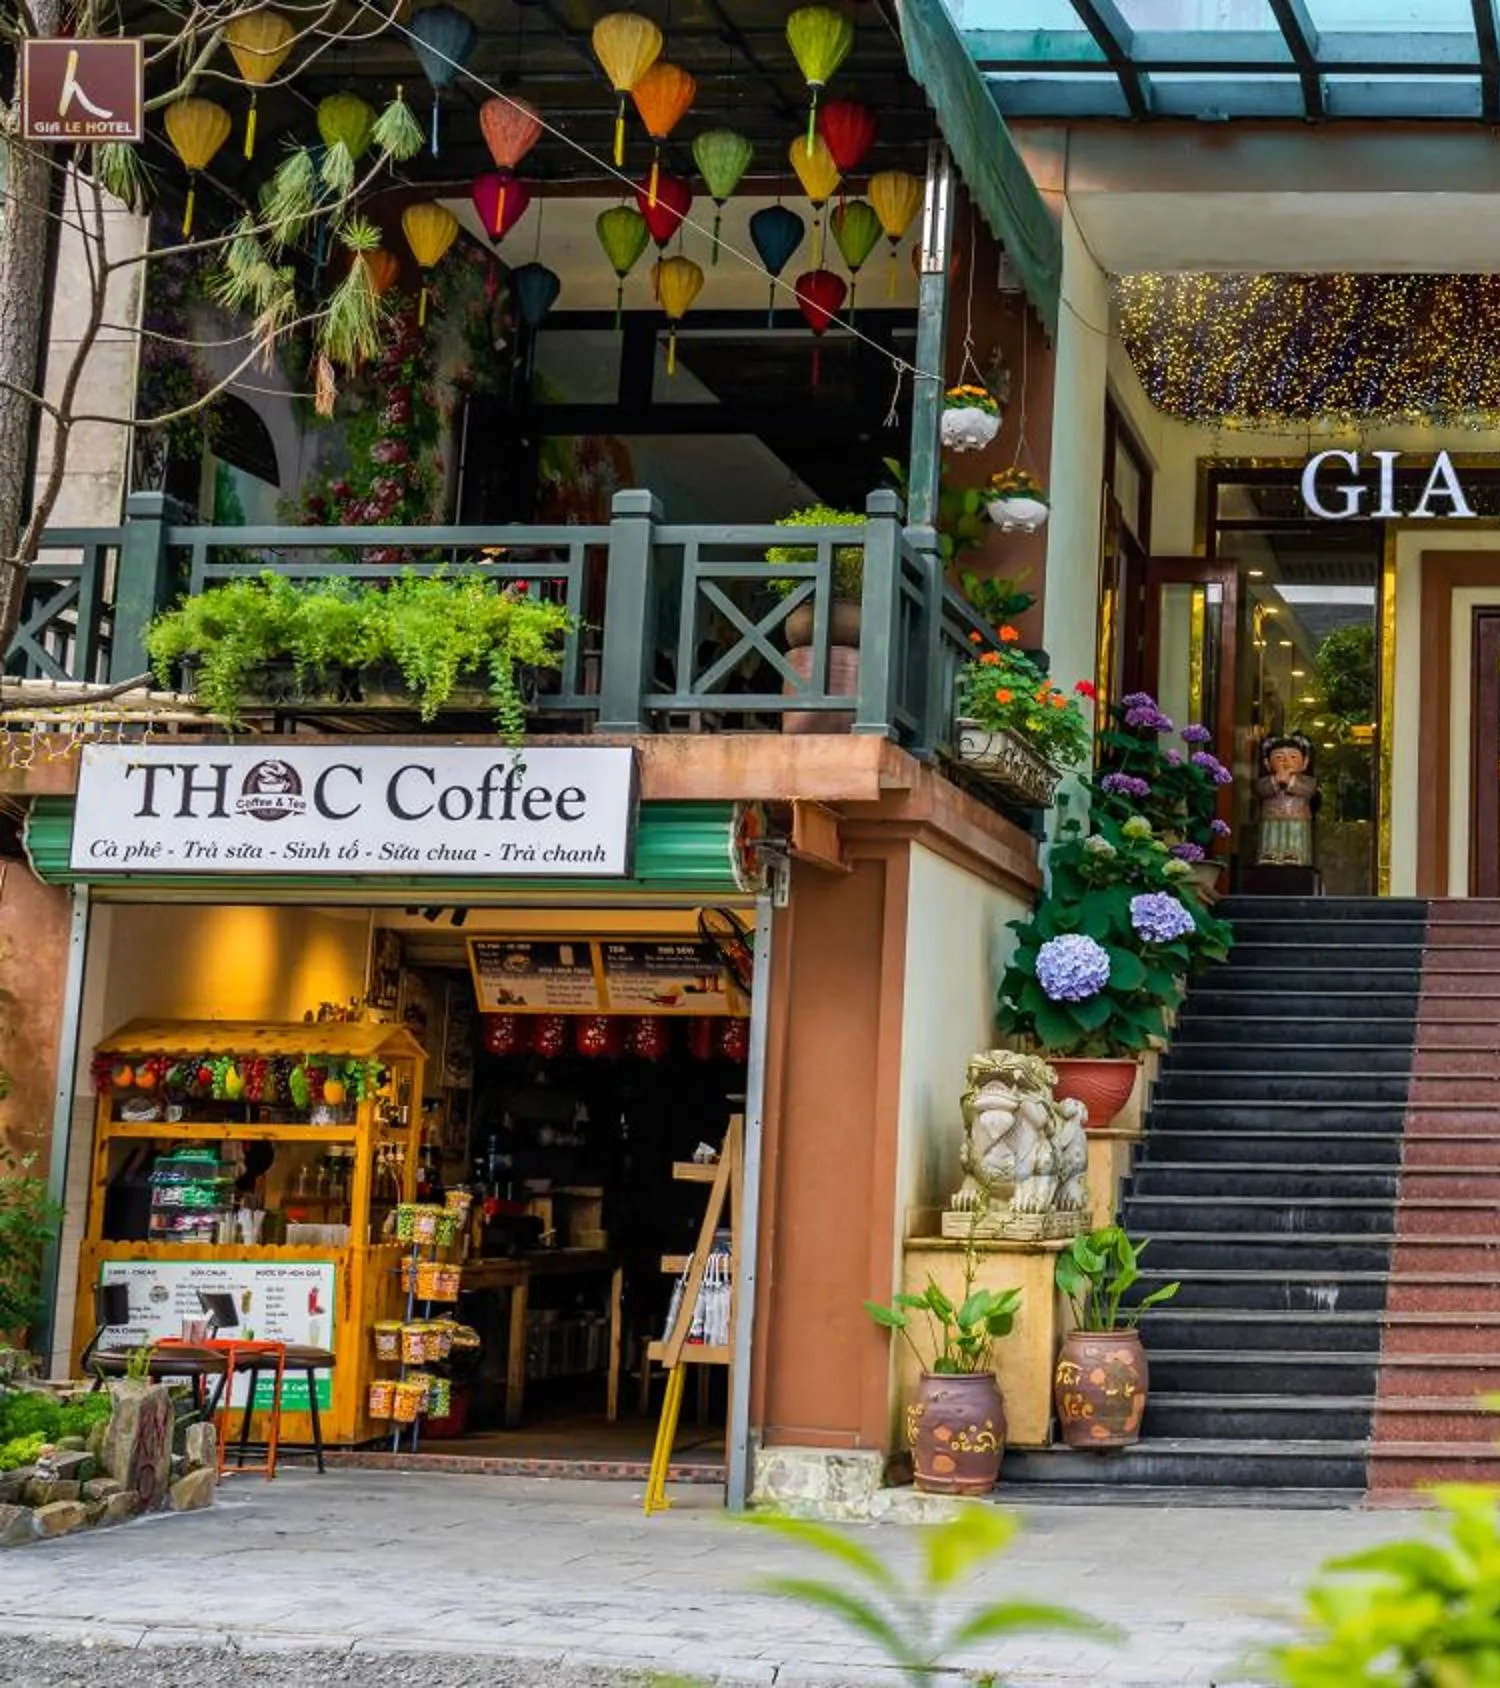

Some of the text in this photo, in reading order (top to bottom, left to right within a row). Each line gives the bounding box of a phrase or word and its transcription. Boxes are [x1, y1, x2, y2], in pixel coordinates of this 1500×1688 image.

[34, 121, 133, 133] GIA LE HOTEL
[1301, 450, 1477, 520] GIA
[386, 763, 587, 821] Coffee
[283, 841, 330, 860] Sinh
[426, 842, 477, 862] chua
[542, 843, 607, 863] chanh
